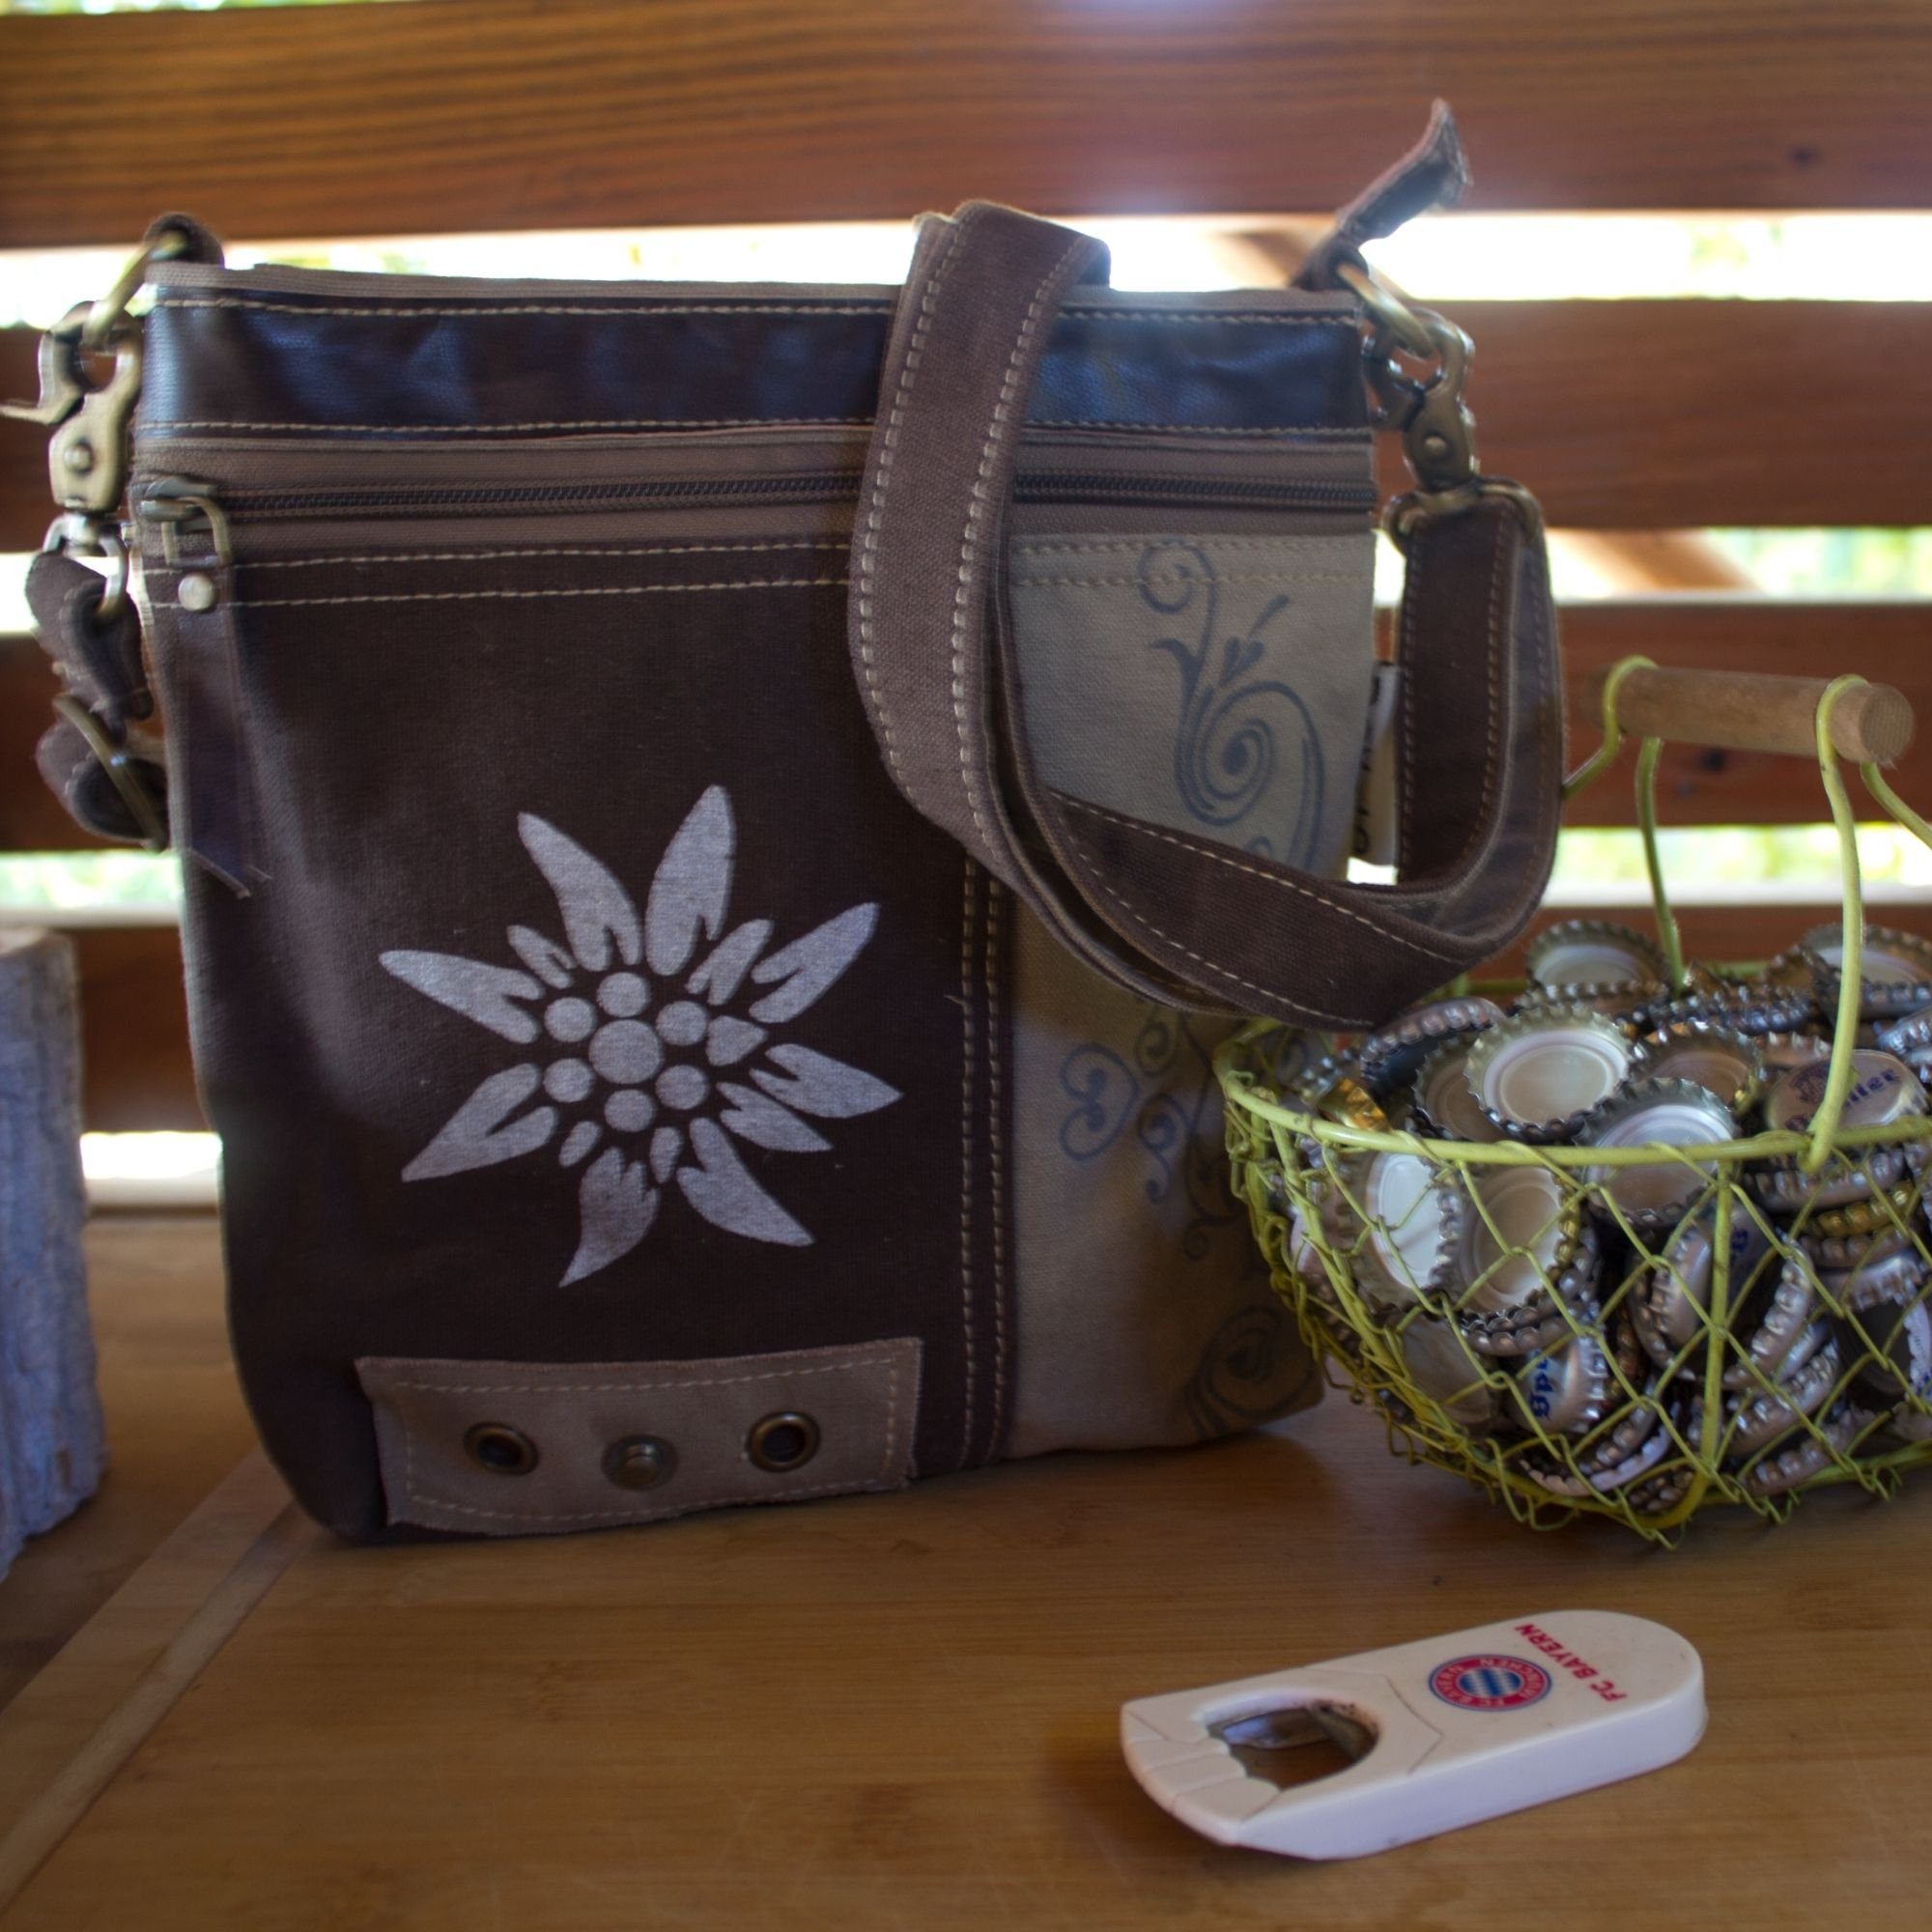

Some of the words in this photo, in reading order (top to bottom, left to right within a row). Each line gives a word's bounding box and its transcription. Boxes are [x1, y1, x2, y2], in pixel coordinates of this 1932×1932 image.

[1514, 1623, 1599, 1680] BAYERN
[1437, 1665, 1473, 1705] BAYERN
[1590, 1680, 1628, 1702] FC
[1480, 1697, 1505, 1708] FC
